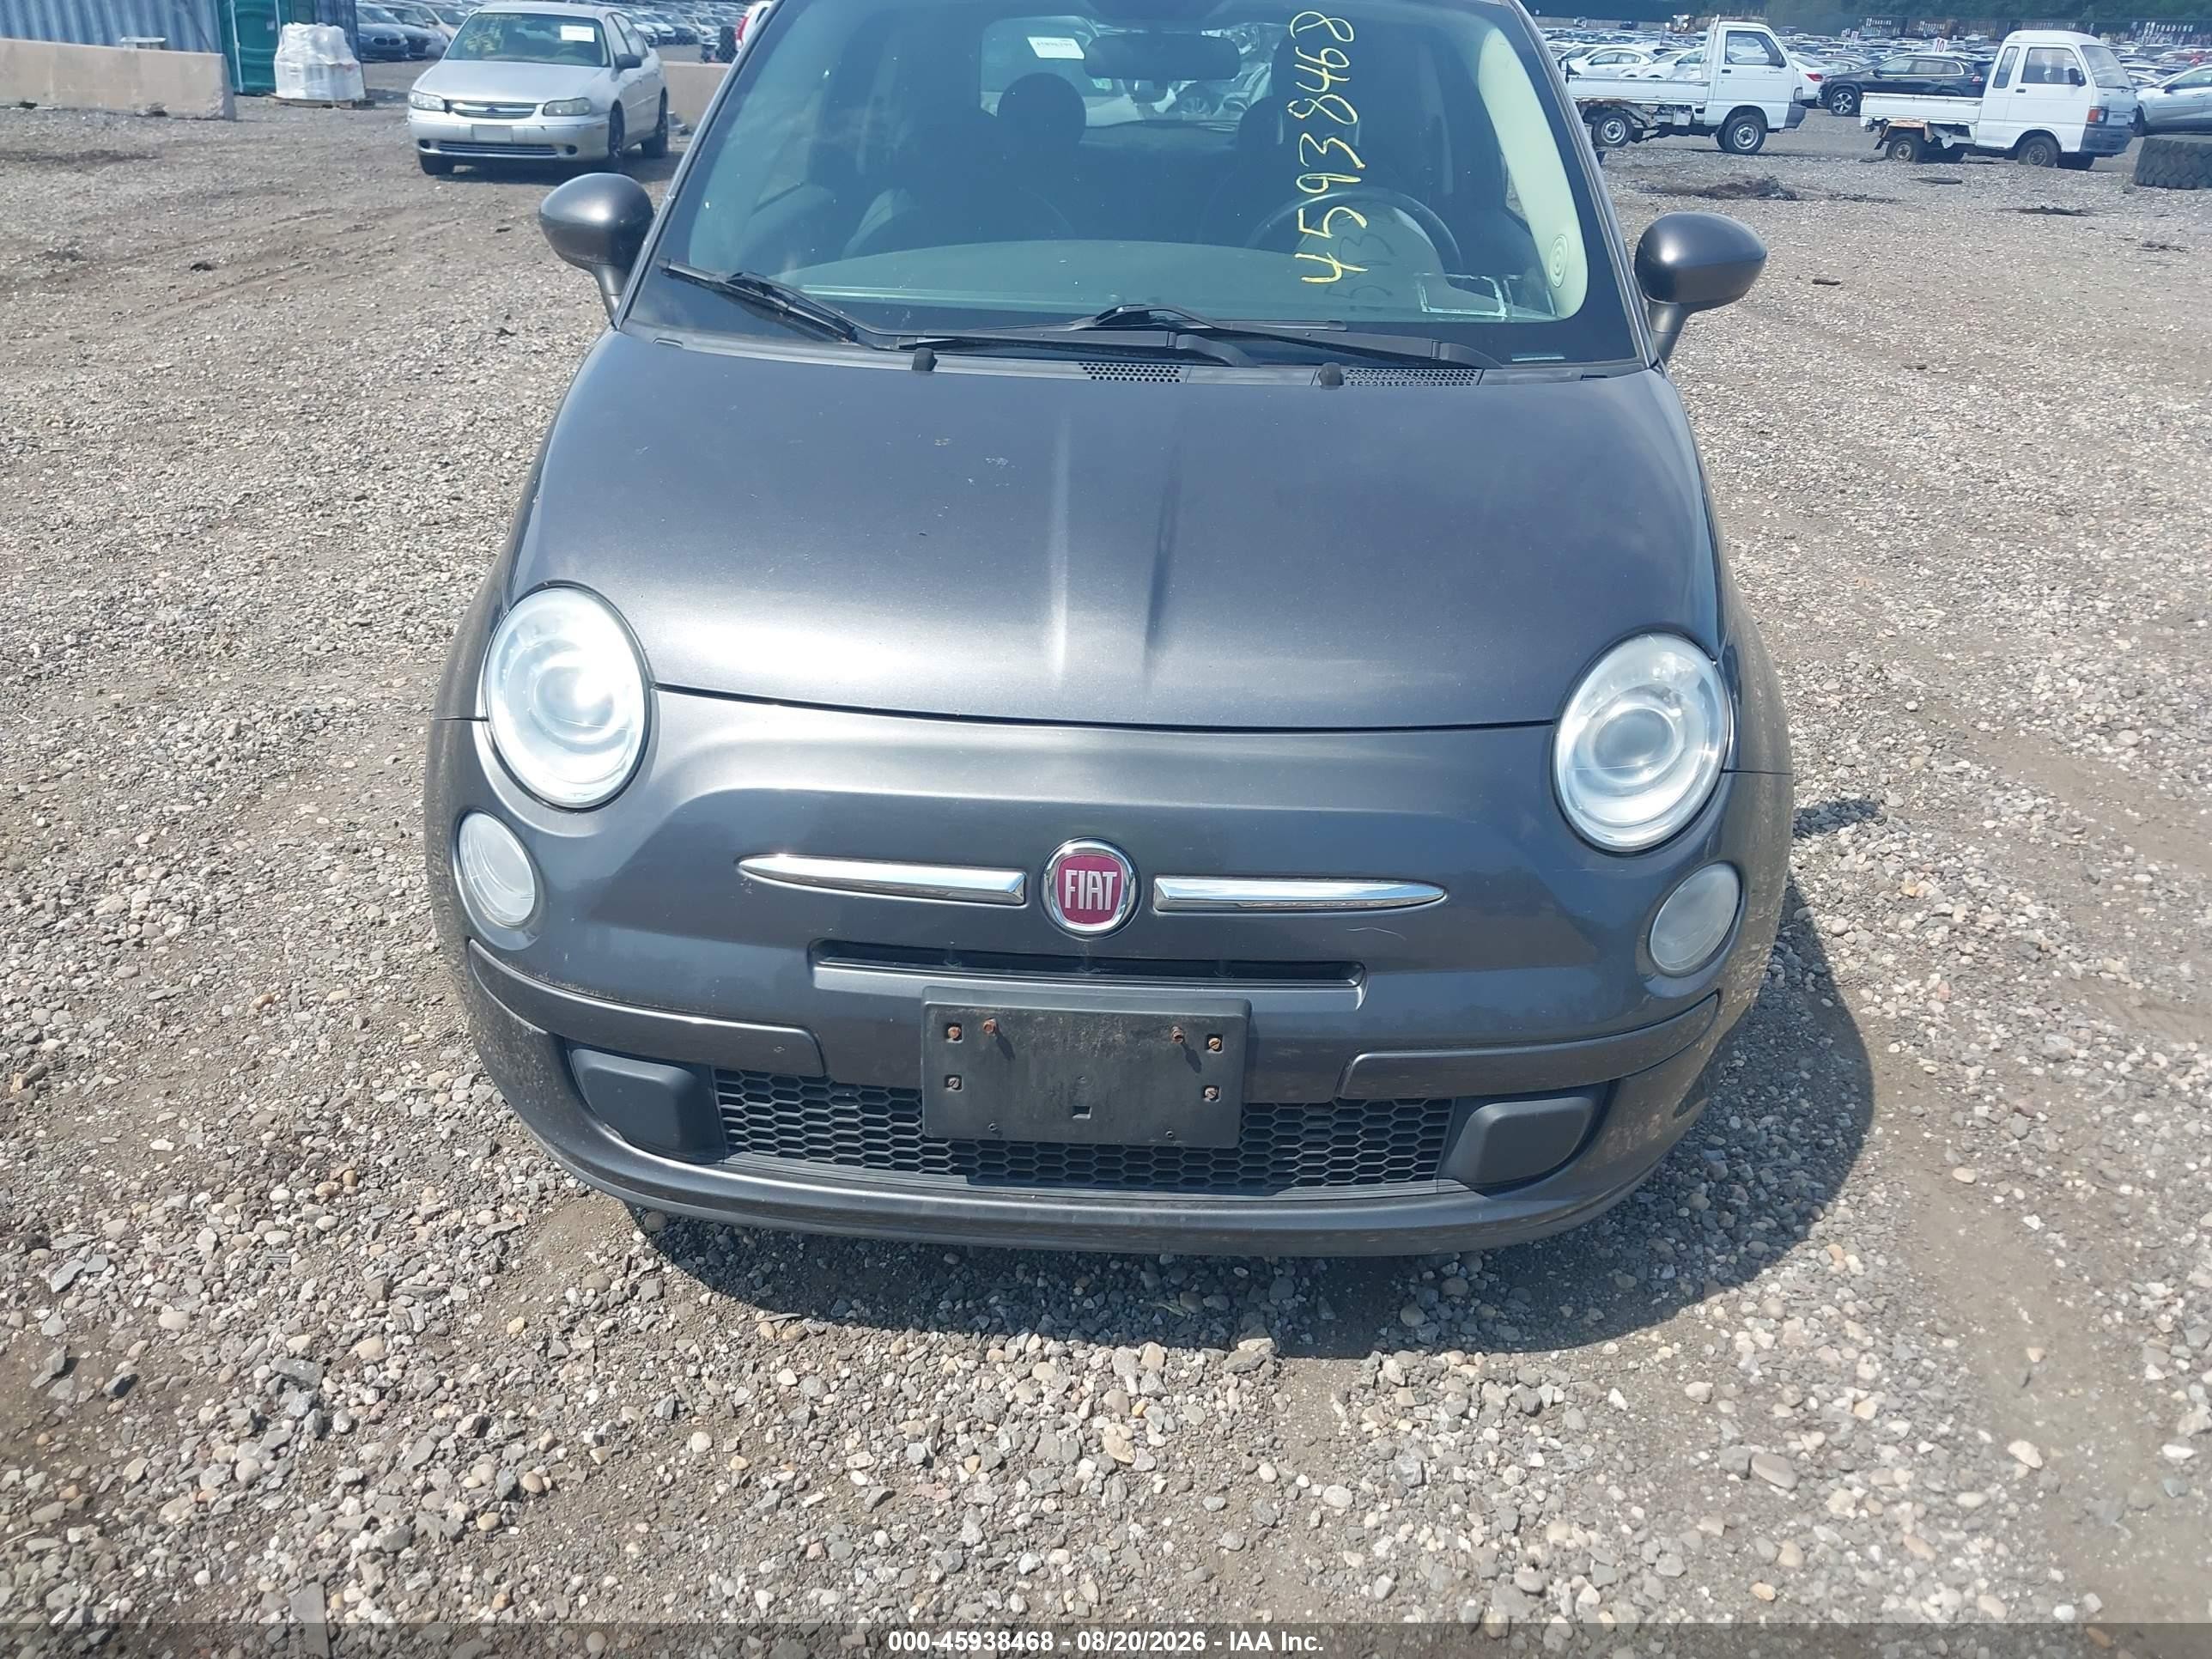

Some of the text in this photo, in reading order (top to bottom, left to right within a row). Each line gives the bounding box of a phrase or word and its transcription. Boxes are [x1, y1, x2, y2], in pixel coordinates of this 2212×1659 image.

[2155, 24, 2194, 33] TRADING
[1936, 39, 1945, 53] 10
[1287, 10, 1369, 283] 45938468
[1065, 869, 1118, 910] FIAT
